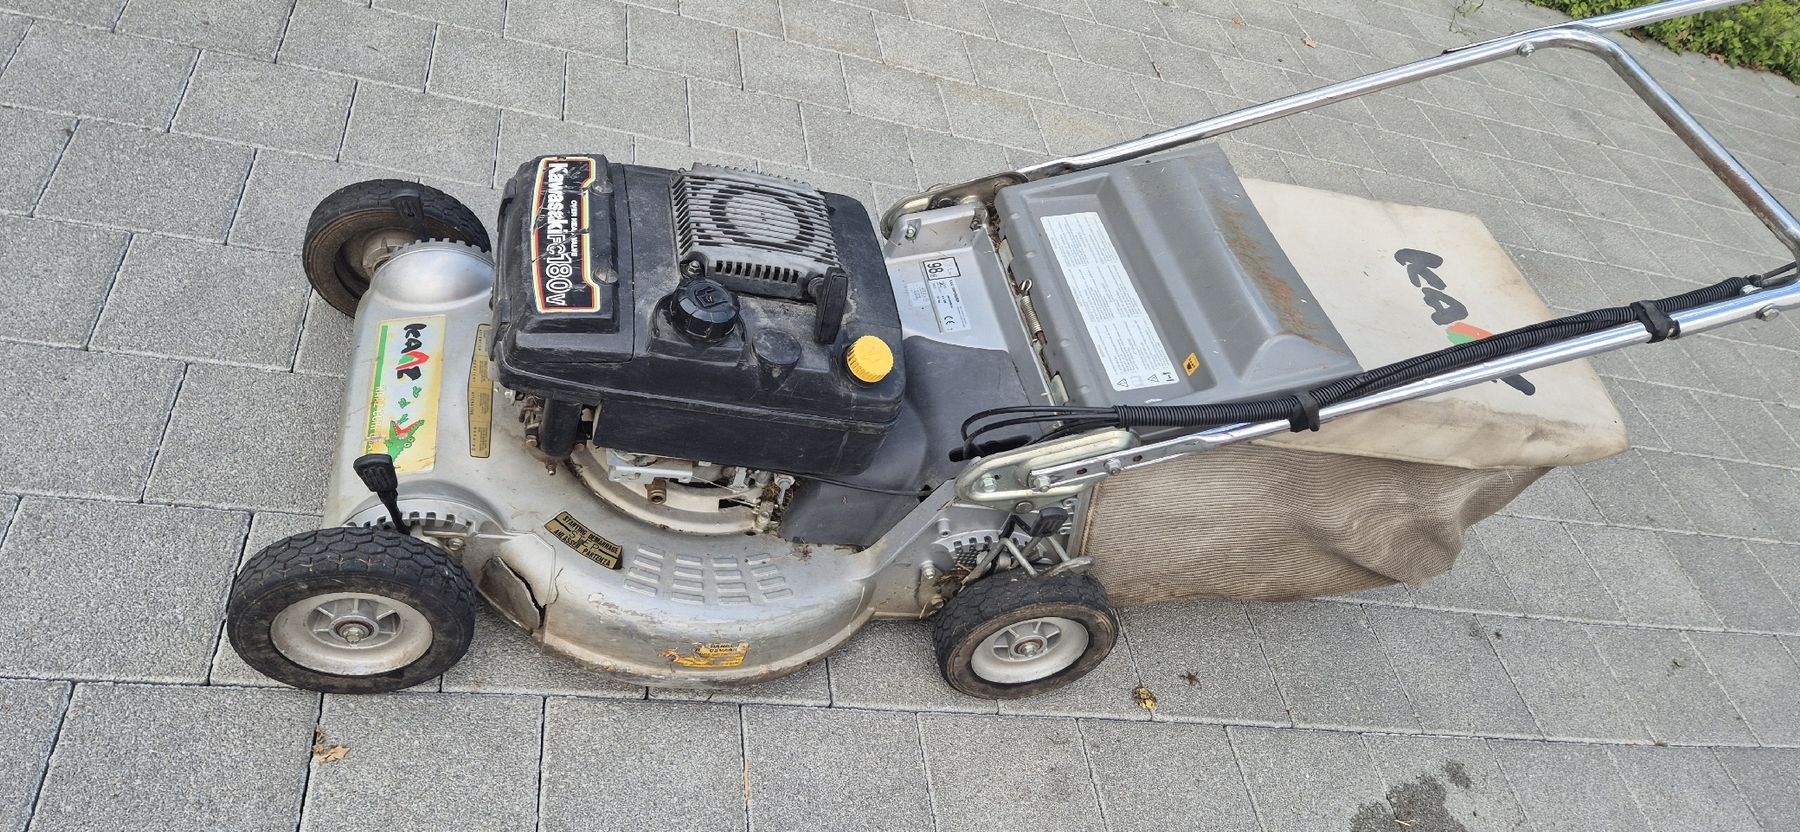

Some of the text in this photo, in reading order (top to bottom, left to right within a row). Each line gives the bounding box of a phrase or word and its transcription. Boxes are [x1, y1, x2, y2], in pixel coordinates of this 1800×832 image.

[546, 162, 569, 234] Kawasaki
[927, 262, 944, 274] 98
[562, 515, 619, 554] STARTING DEMARRAGE
[582, 548, 611, 567] PARTENZA
